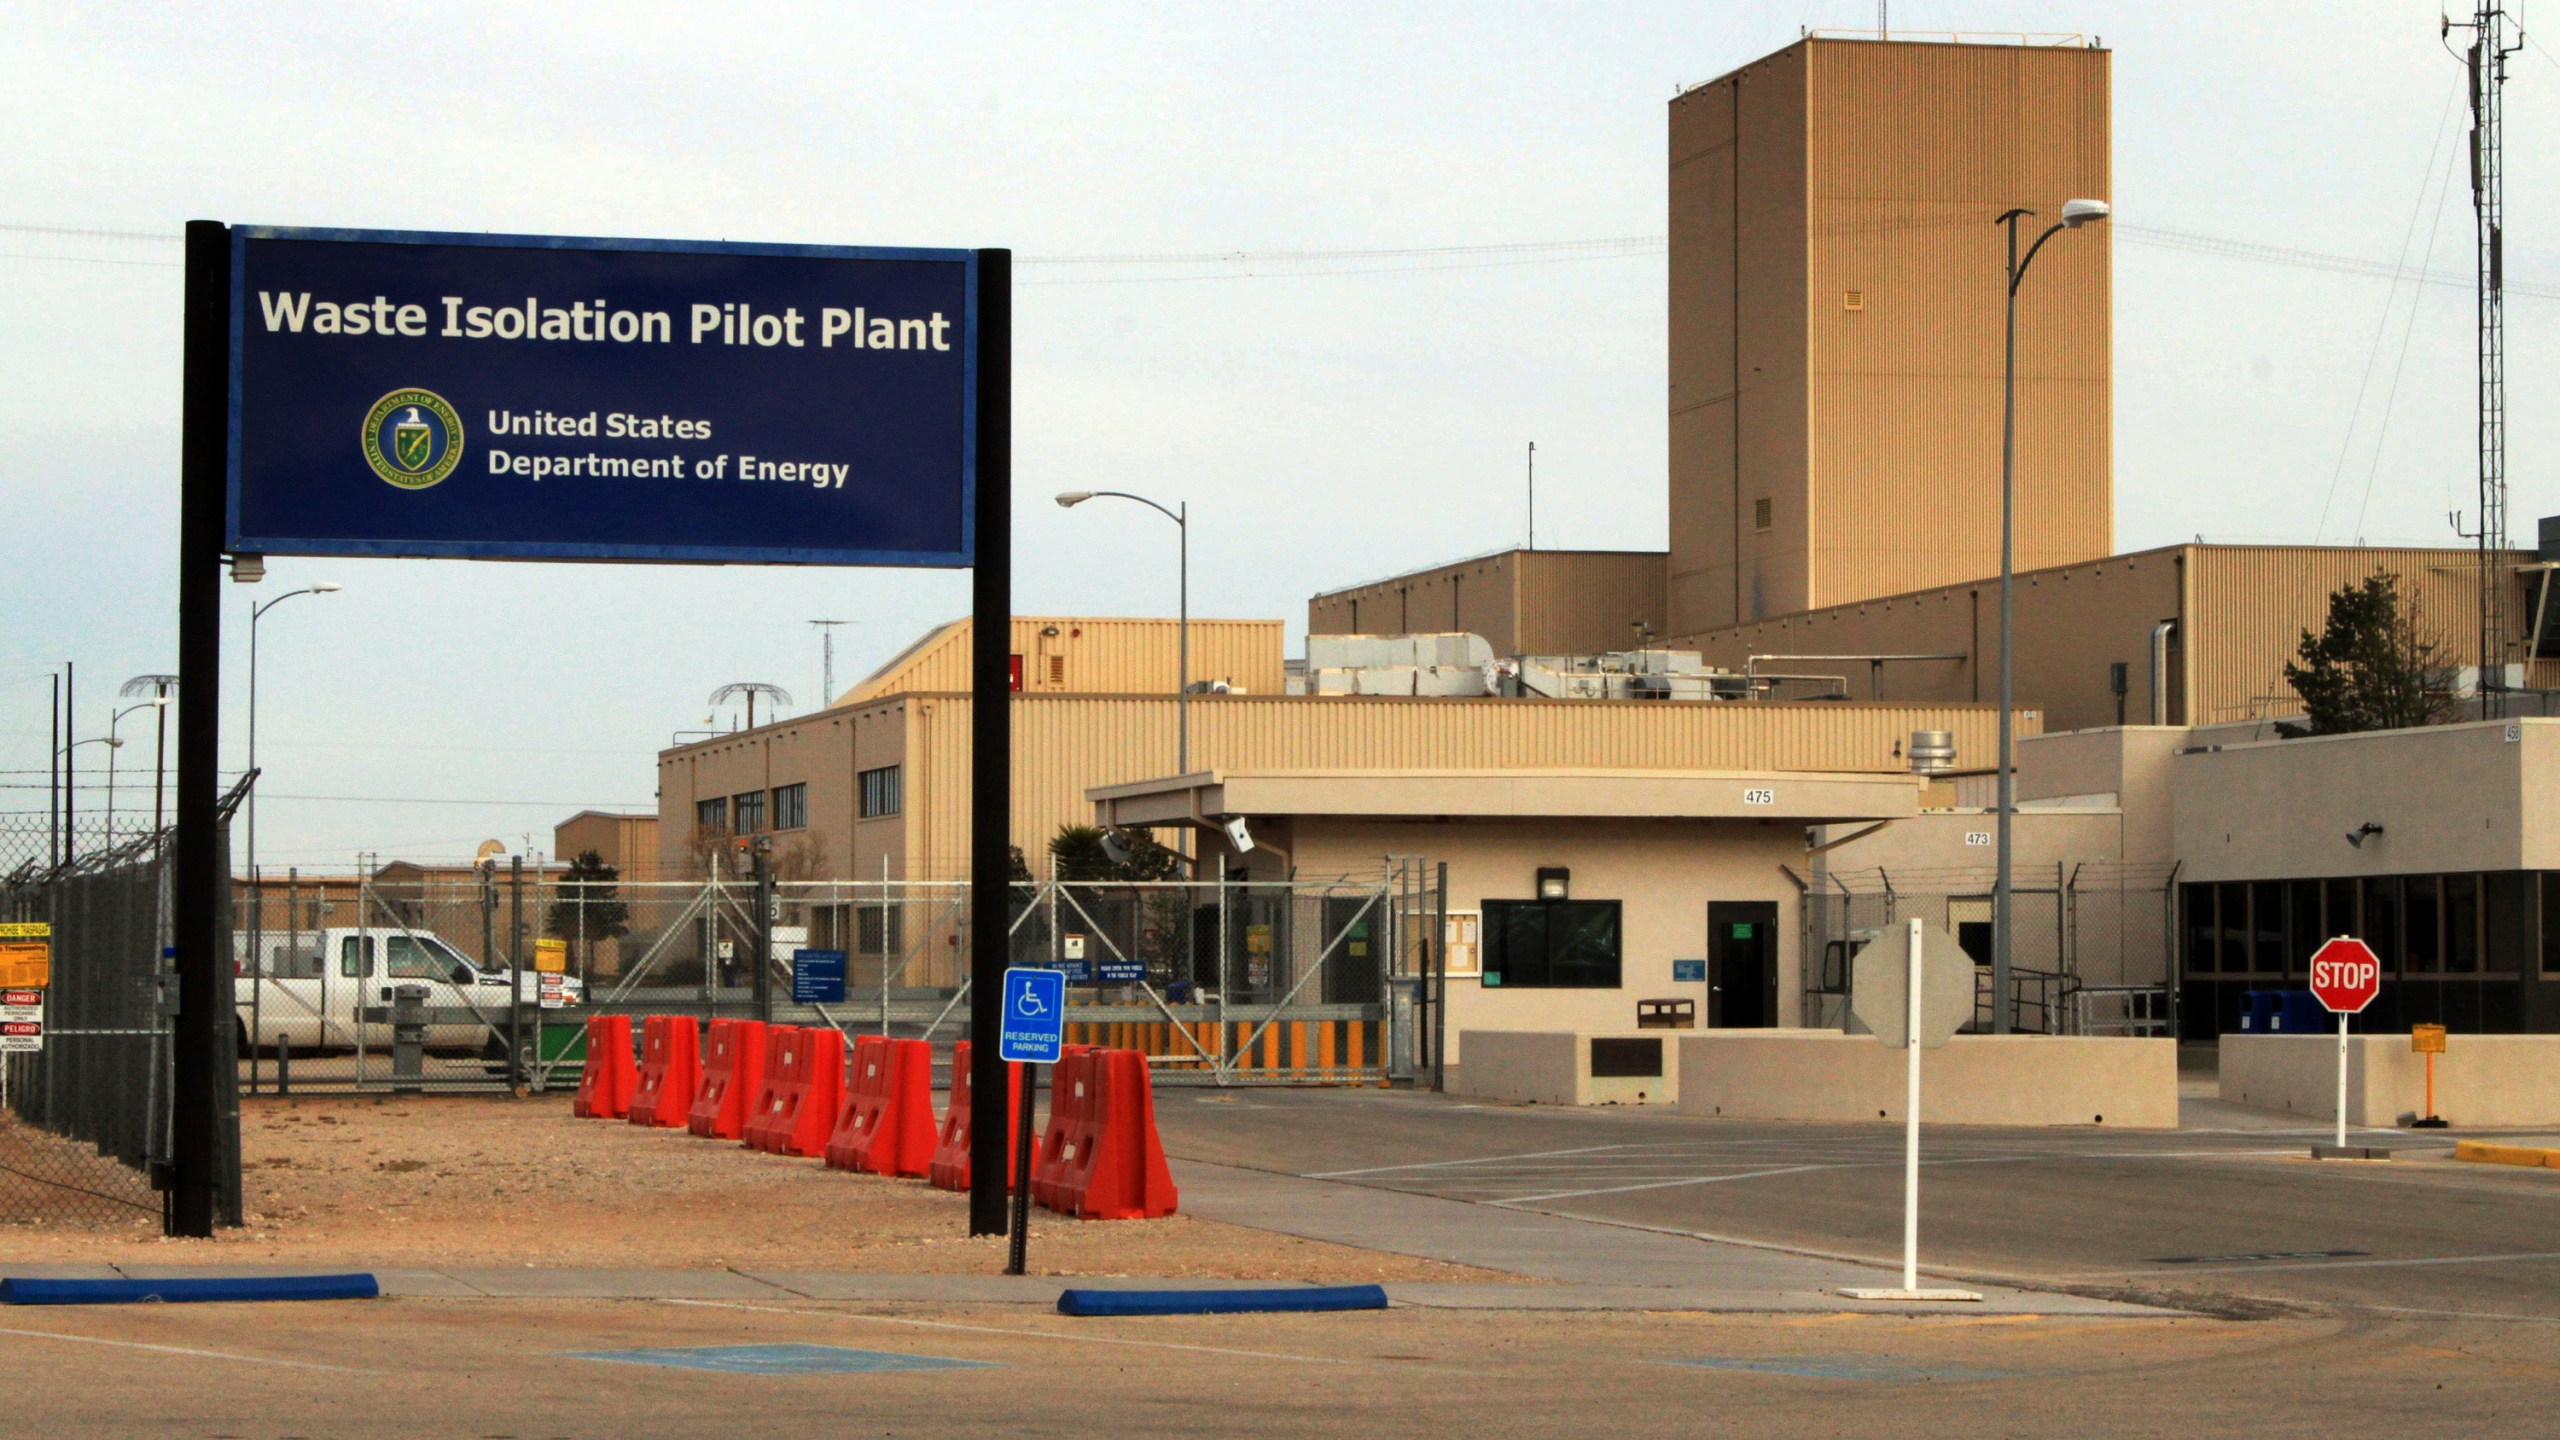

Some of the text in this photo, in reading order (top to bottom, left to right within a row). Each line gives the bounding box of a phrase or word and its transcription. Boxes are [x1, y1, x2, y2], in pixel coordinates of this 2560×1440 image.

[258, 291, 951, 351] Waste Isolation Pilot Plant
[368, 394, 459, 435] DEPARTMENT OF ENERGY
[488, 410, 712, 439] United States
[367, 436, 389, 473] UNITED
[488, 450, 850, 488] Department of Energy
[1746, 791, 1771, 803] 475
[1967, 833, 1989, 845] 473
[2315, 961, 2375, 990] STOP
[6, 995, 36, 1003] DANGER
[4, 1024, 36, 1033] PELIGRO
[1005, 1031, 1058, 1043] RESERVED
[1012, 1042, 1049, 1053] PARKING
